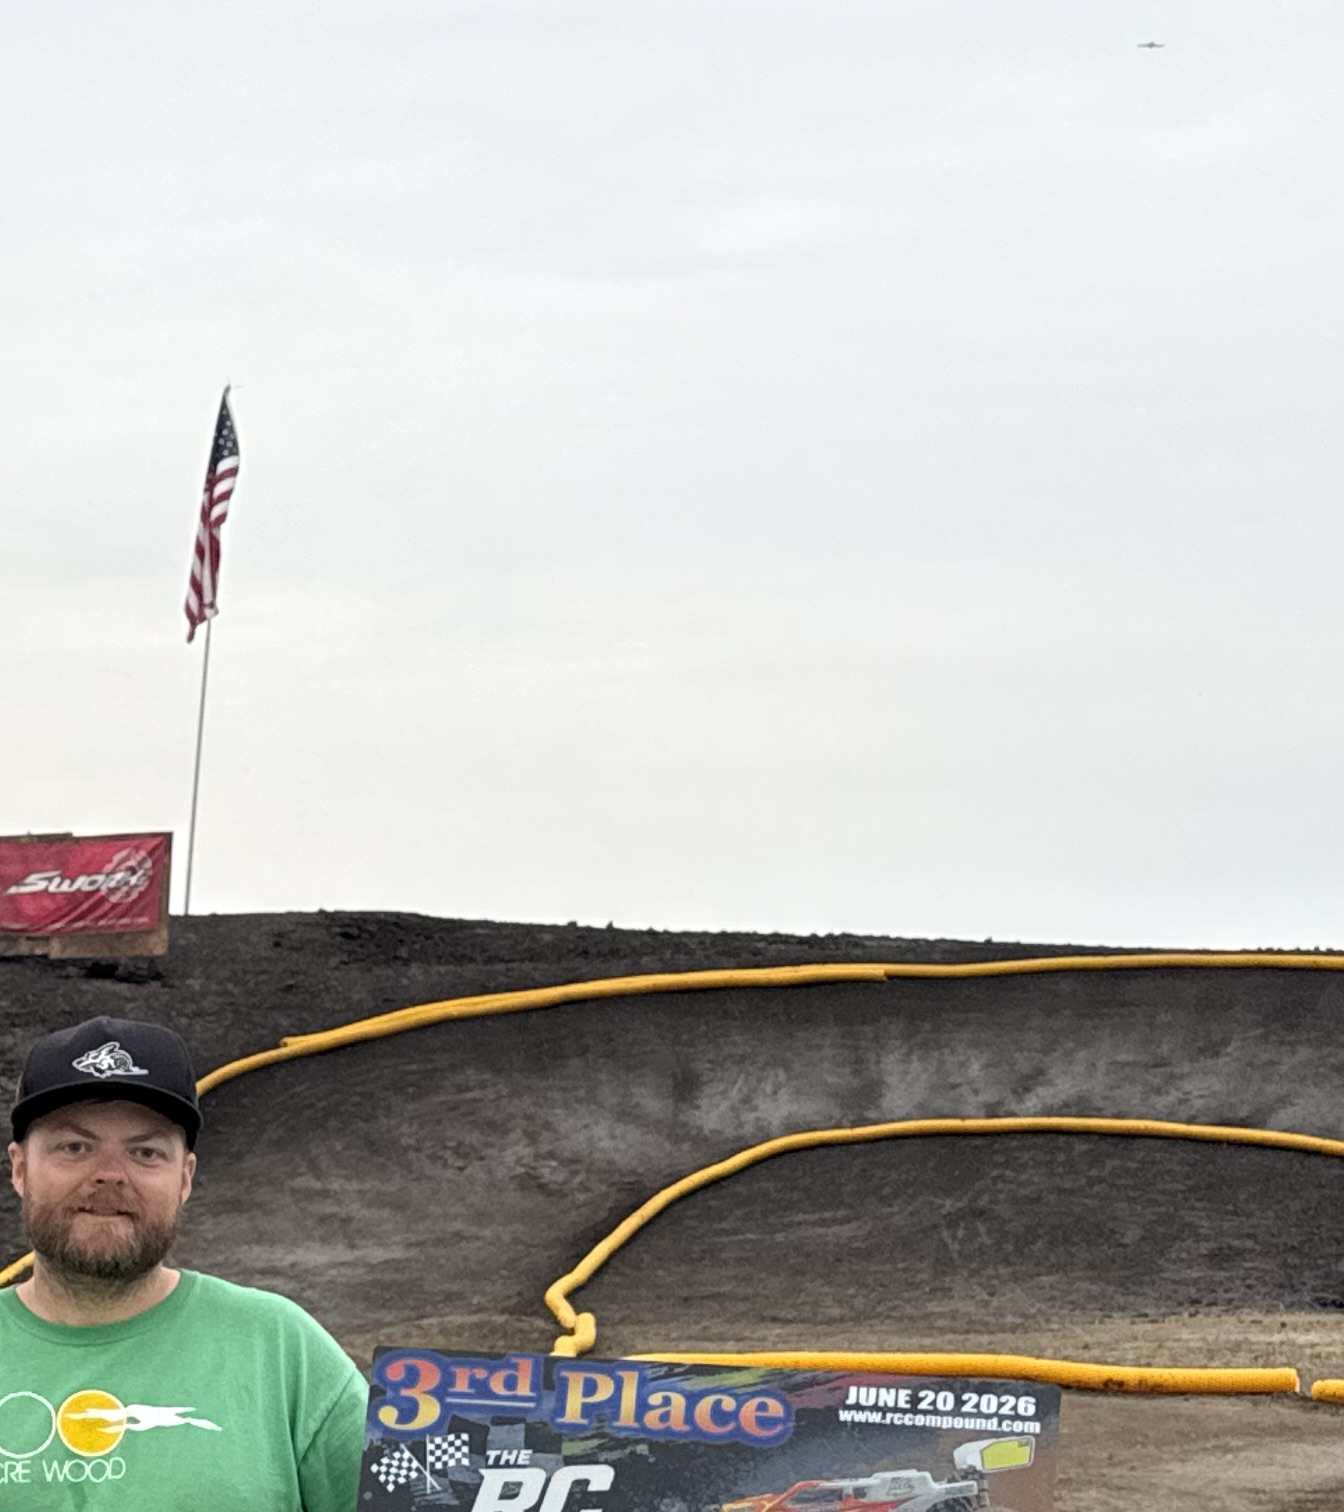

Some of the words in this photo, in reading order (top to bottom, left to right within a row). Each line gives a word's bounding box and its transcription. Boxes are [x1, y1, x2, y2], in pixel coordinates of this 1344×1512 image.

[378, 1357, 536, 1430] 3rd
[555, 1370, 784, 1437] Place
[845, 1386, 912, 1409] JUNE
[917, 1390, 955, 1411] 20
[961, 1393, 1037, 1417] 2026
[839, 1409, 1041, 1434] www.rccompound.com
[43, 1456, 127, 1484] WOOD
[485, 1449, 533, 1465] THE
